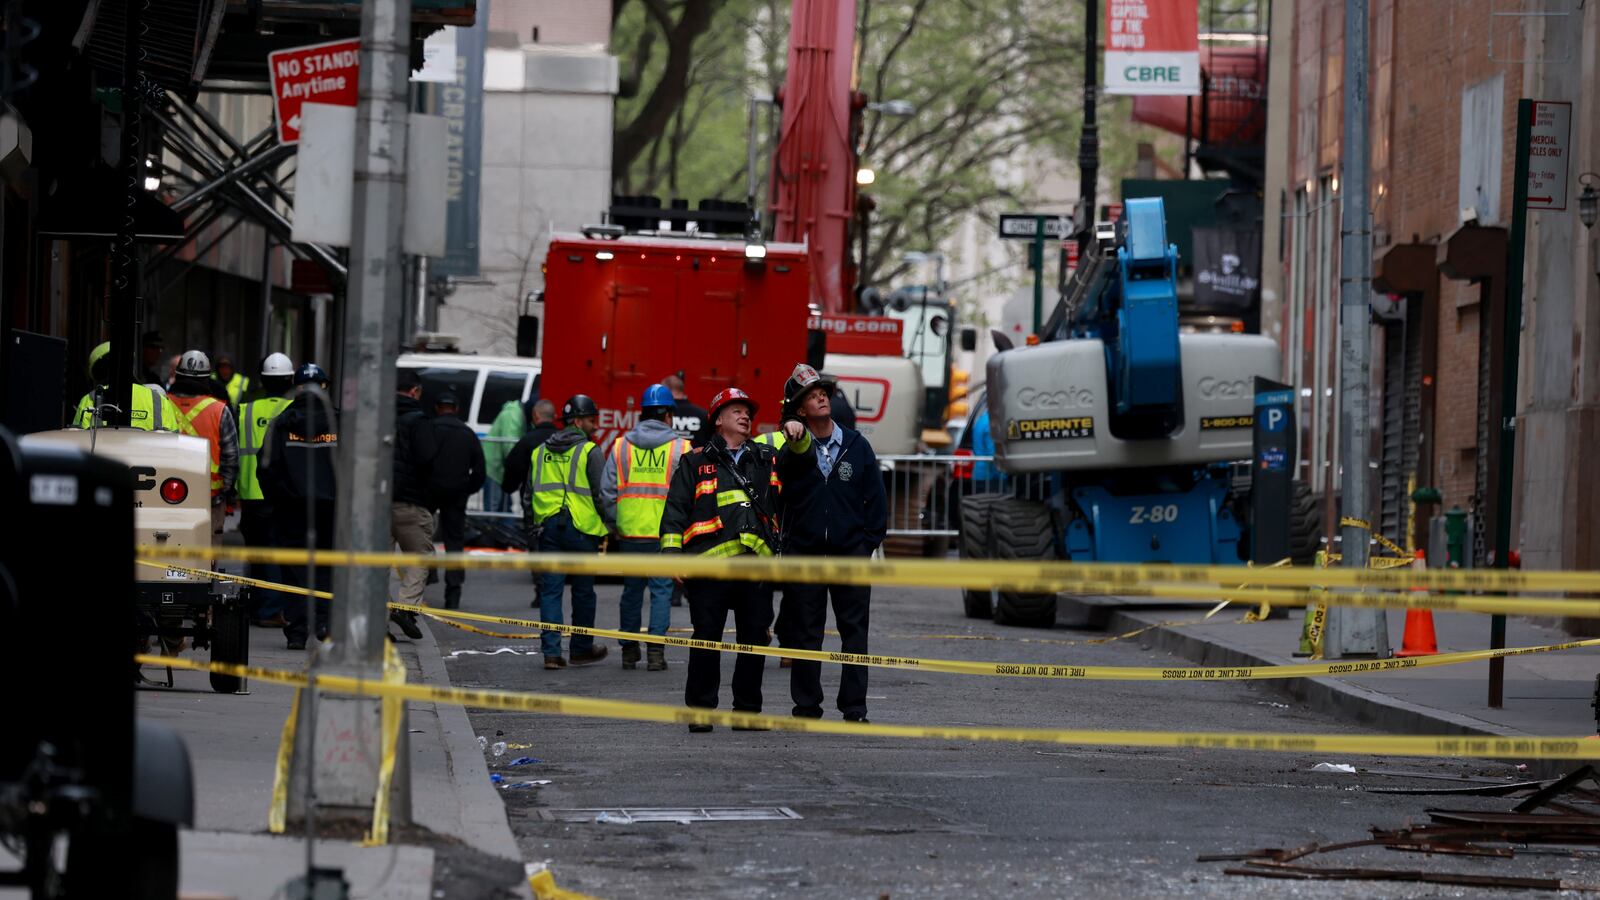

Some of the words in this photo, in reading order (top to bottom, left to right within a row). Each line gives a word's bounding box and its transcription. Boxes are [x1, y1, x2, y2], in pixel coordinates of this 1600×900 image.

[277, 59, 301, 78] NO
[1123, 66, 1181, 82] CBRE
[281, 75, 346, 99] Anytime
[1548, 147, 1562, 157] ONLY
[1011, 222, 1034, 232] ONE
[1046, 222, 1070, 232] WAY
[1017, 386, 1094, 411] Genie
[1268, 408, 1282, 431] P
[1020, 418, 1093, 432] DURANTE
[1025, 429, 1089, 439] RENTALS
[634, 448, 666, 467] VM
[1129, 504, 1178, 524] Z-80
[830, 652, 853, 661] CROSS
[995, 665, 1020, 674] CROSS
[1022, 666, 1036, 675] NOT
[1038, 666, 1048, 676] DO
[1051, 666, 1067, 676] LINE
[1328, 665, 1352, 674] CROSS
[1354, 663, 1368, 672] NOT
[1370, 662, 1380, 670] DO
[1070, 667, 1086, 677] FIRE
[1162, 669, 1186, 678] CROSS
[1188, 669, 1202, 678] NOT
[1204, 669, 1214, 678] DO
[1218, 669, 1234, 678] LINE
[1236, 668, 1252, 677] FIRE
